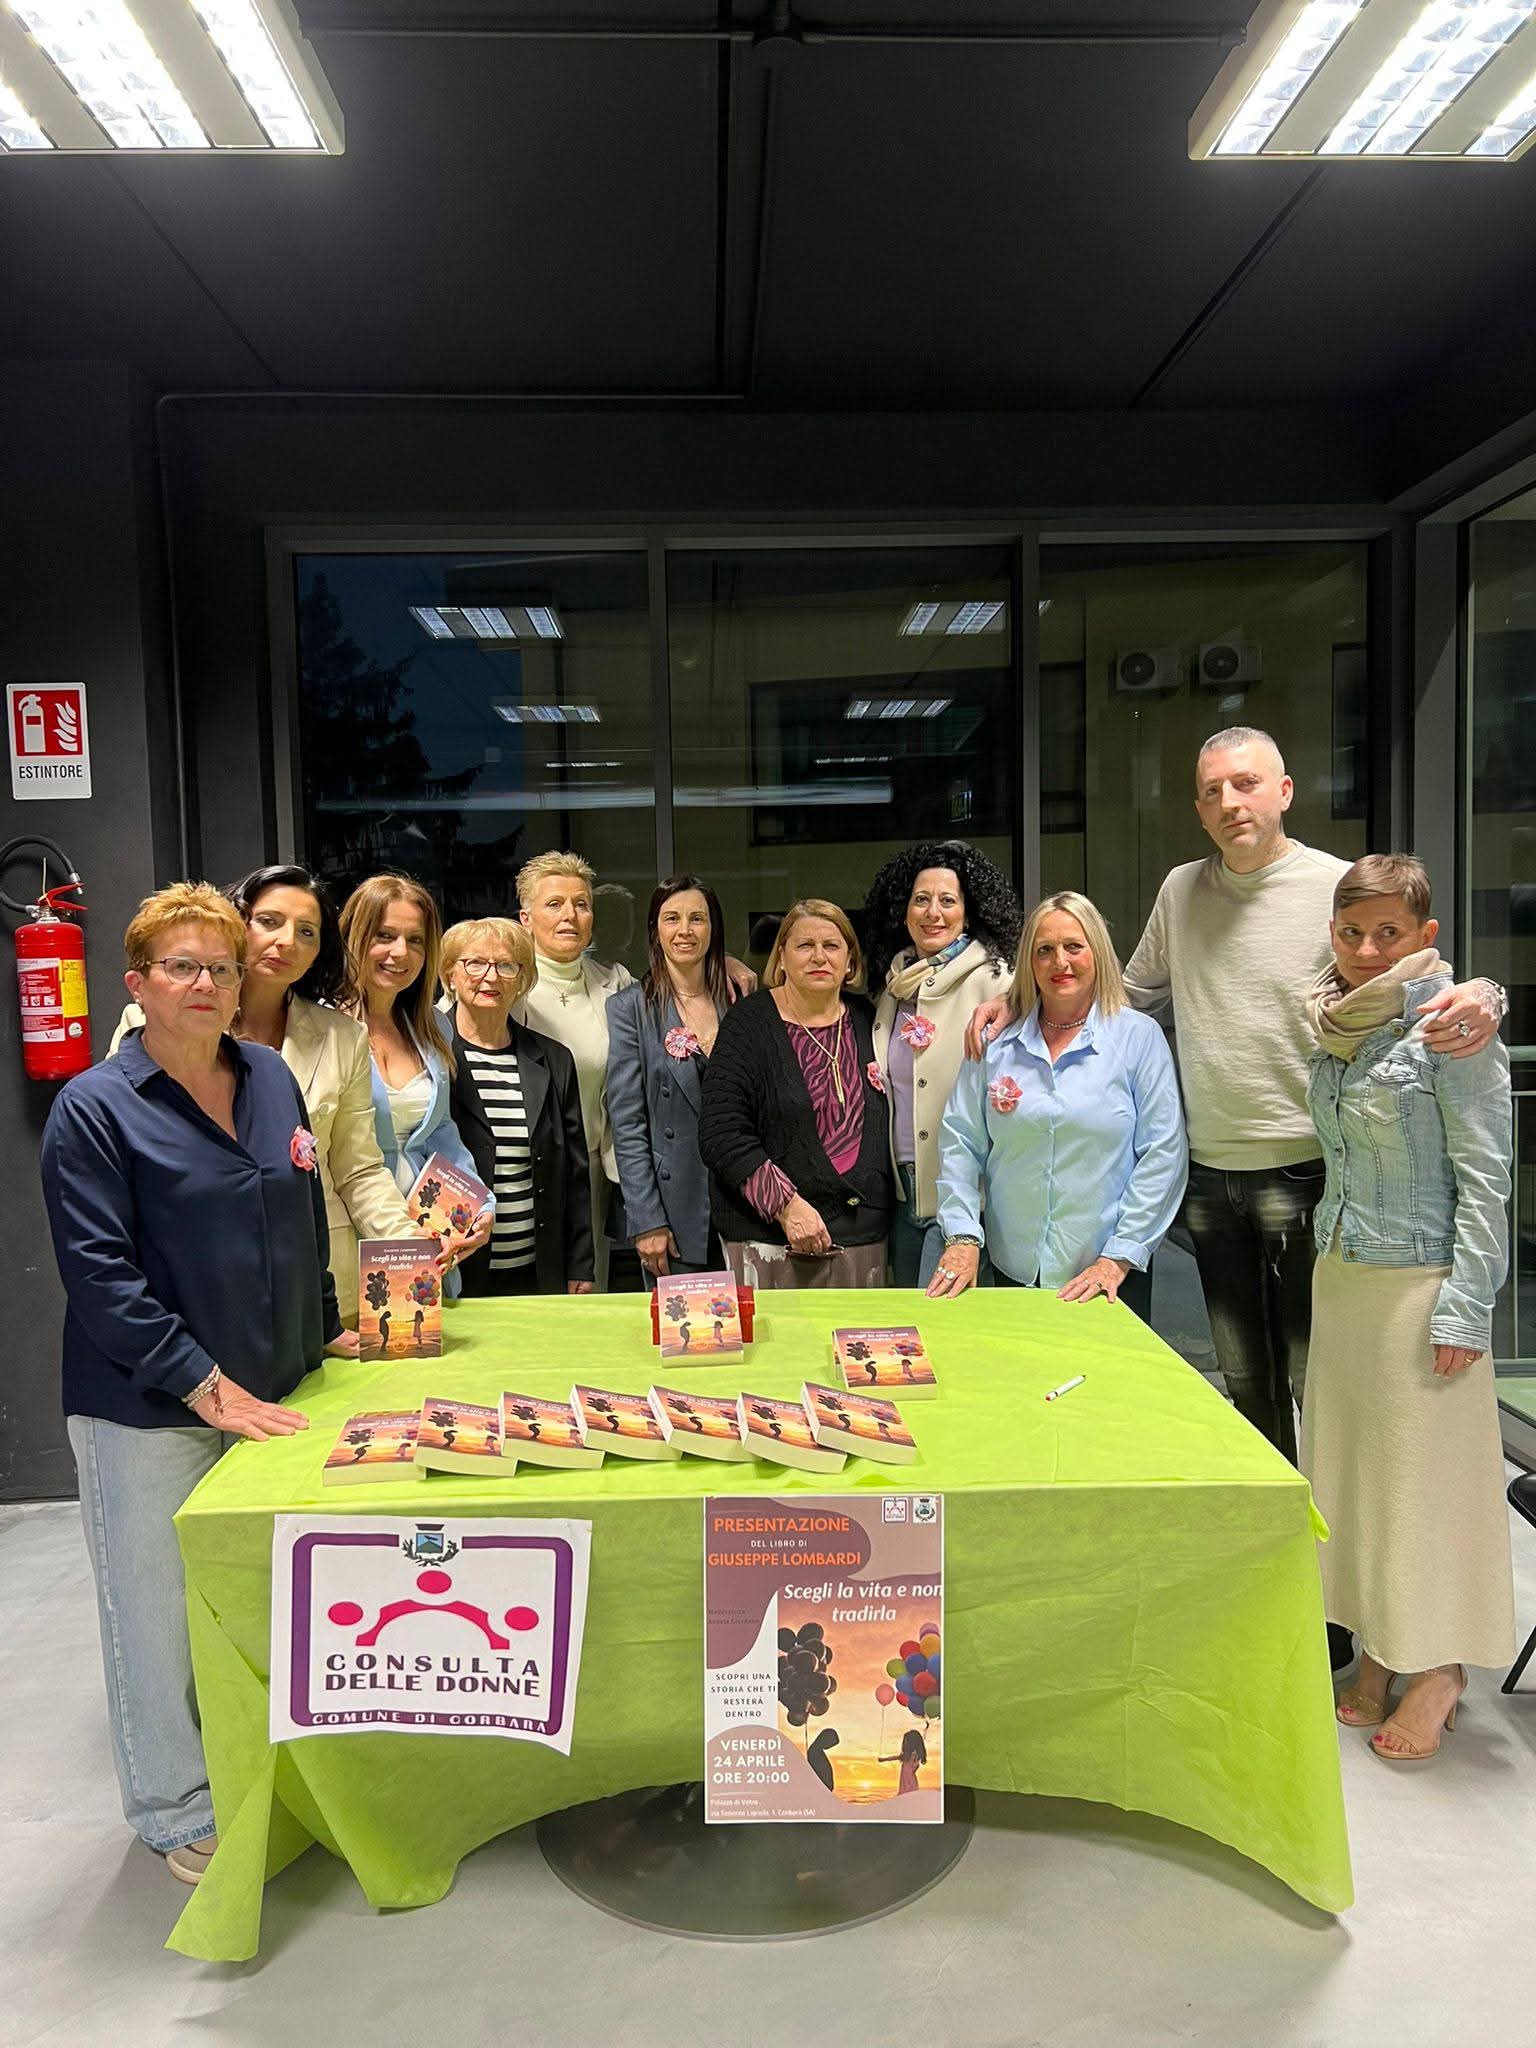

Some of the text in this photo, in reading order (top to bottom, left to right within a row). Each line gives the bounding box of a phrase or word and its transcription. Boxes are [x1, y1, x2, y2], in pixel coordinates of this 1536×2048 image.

[19, 765, 83, 779] ESTINTORE
[371, 1255, 389, 1263] Scegli
[713, 1517, 850, 1532] PRESENTAZIONE
[750, 1539, 808, 1548] DEL LIBRO DI
[708, 1552, 861, 1566] GIUSEPPE LOMBARDI
[783, 1582, 832, 1603] Scegli
[837, 1582, 853, 1598] la
[859, 1583, 892, 1598] vita
[897, 1586, 907, 1597] e
[832, 1605, 896, 1622] tradirla
[326, 1653, 540, 1677] CONSULTA
[325, 1673, 540, 1697] DELLE DONNE
[725, 1710, 762, 1718] DENTRO
[312, 1711, 547, 1733] COMUNE DI CORBARA
[720, 1735, 782, 1751] VENERDÌ
[713, 1755, 785, 1767] 24 APRILE
[713, 1771, 790, 1784] ORE 20:00
